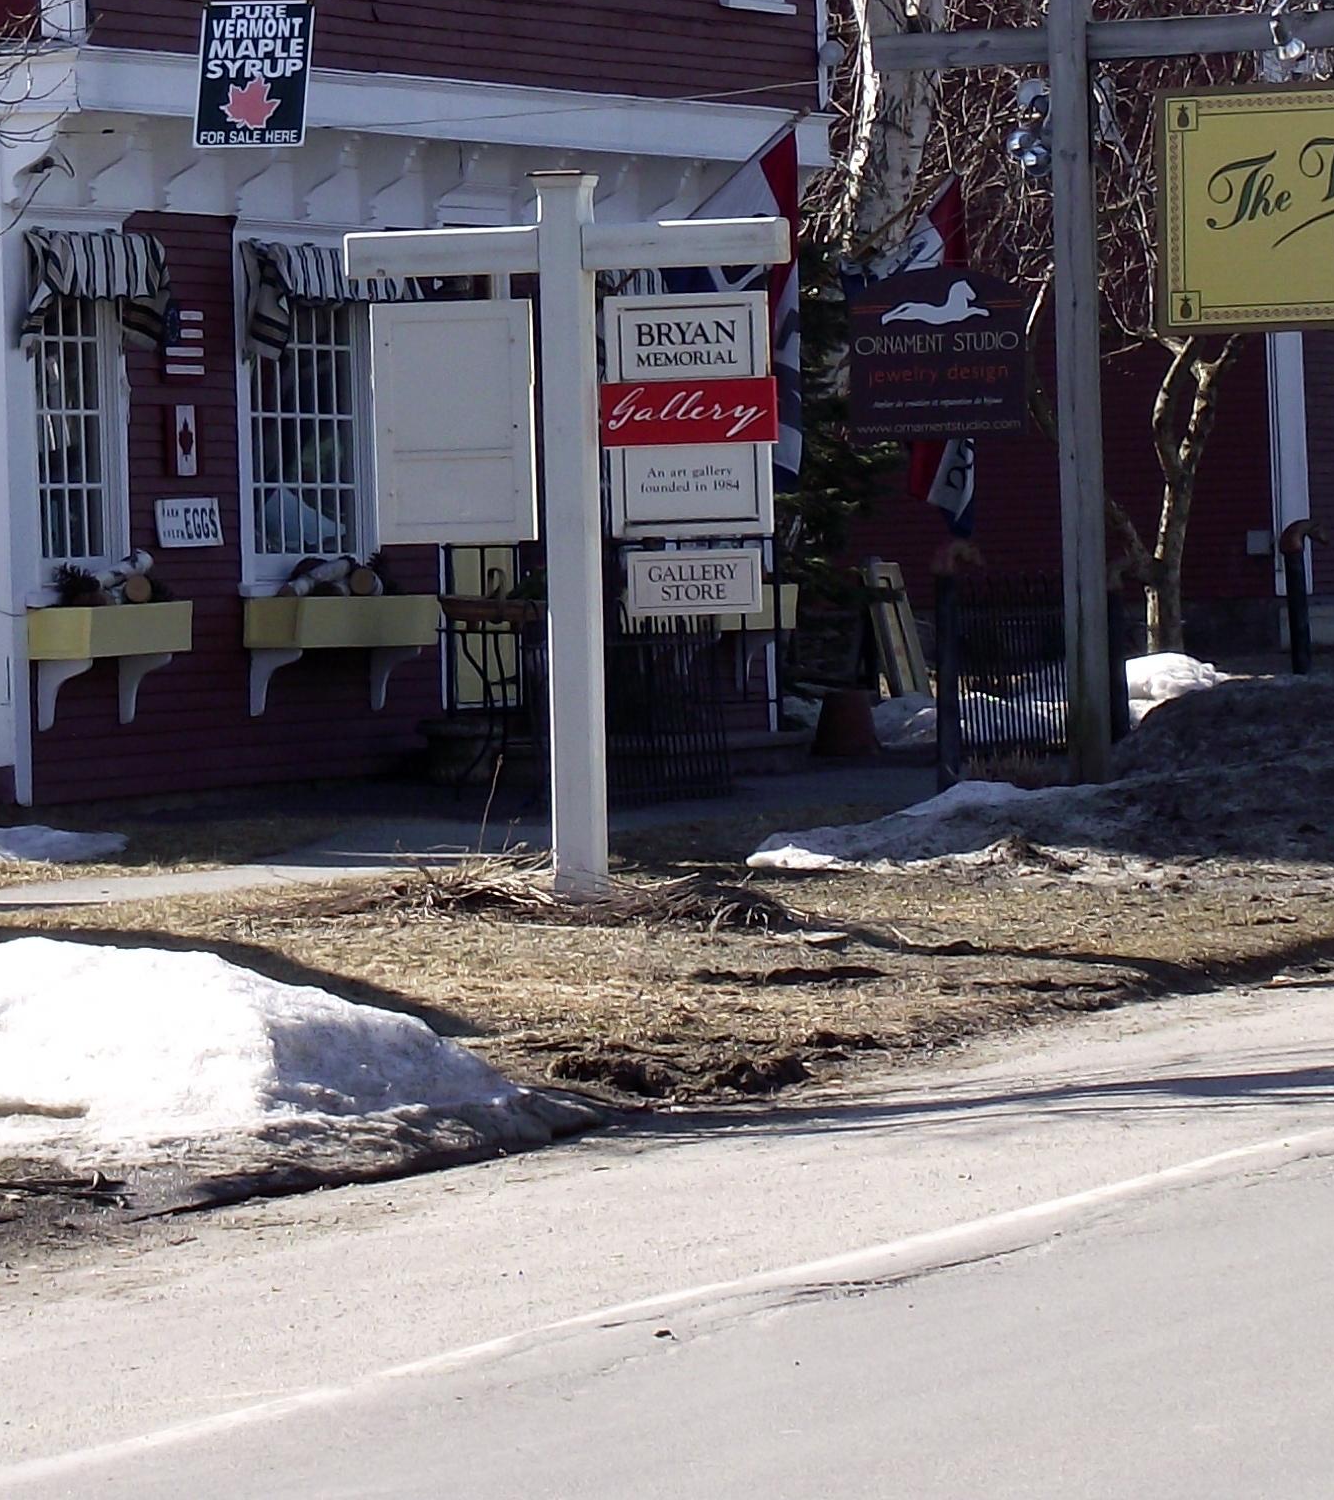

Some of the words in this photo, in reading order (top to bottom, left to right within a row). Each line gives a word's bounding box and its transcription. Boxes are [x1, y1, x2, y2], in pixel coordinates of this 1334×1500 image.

[231, 5, 288, 19] PURE
[212, 17, 304, 39] VERMONT
[208, 38, 305, 59] MAPLE
[205, 58, 304, 79] SYRUP
[200, 131, 225, 144] FOR
[229, 130, 261, 144] SALE
[265, 129, 298, 143] HERE
[1206, 150, 1292, 230] The
[635, 320, 736, 348] BRYAN
[855, 334, 946, 356] ORNAMENT
[953, 331, 1019, 352] STUDIO
[636, 350, 738, 368] MEMORIAL
[868, 365, 938, 388] jewelry
[947, 363, 1010, 383] design
[608, 387, 768, 438] Gallery
[647, 467, 665, 479] An
[670, 467, 687, 478] art
[692, 465, 733, 480] gallery
[641, 481, 690, 493] founded
[695, 481, 708, 492] in
[713, 480, 740, 491] 1984
[184, 507, 218, 540] EGGS
[648, 563, 738, 583] GALLERY
[661, 583, 727, 601] STORE
